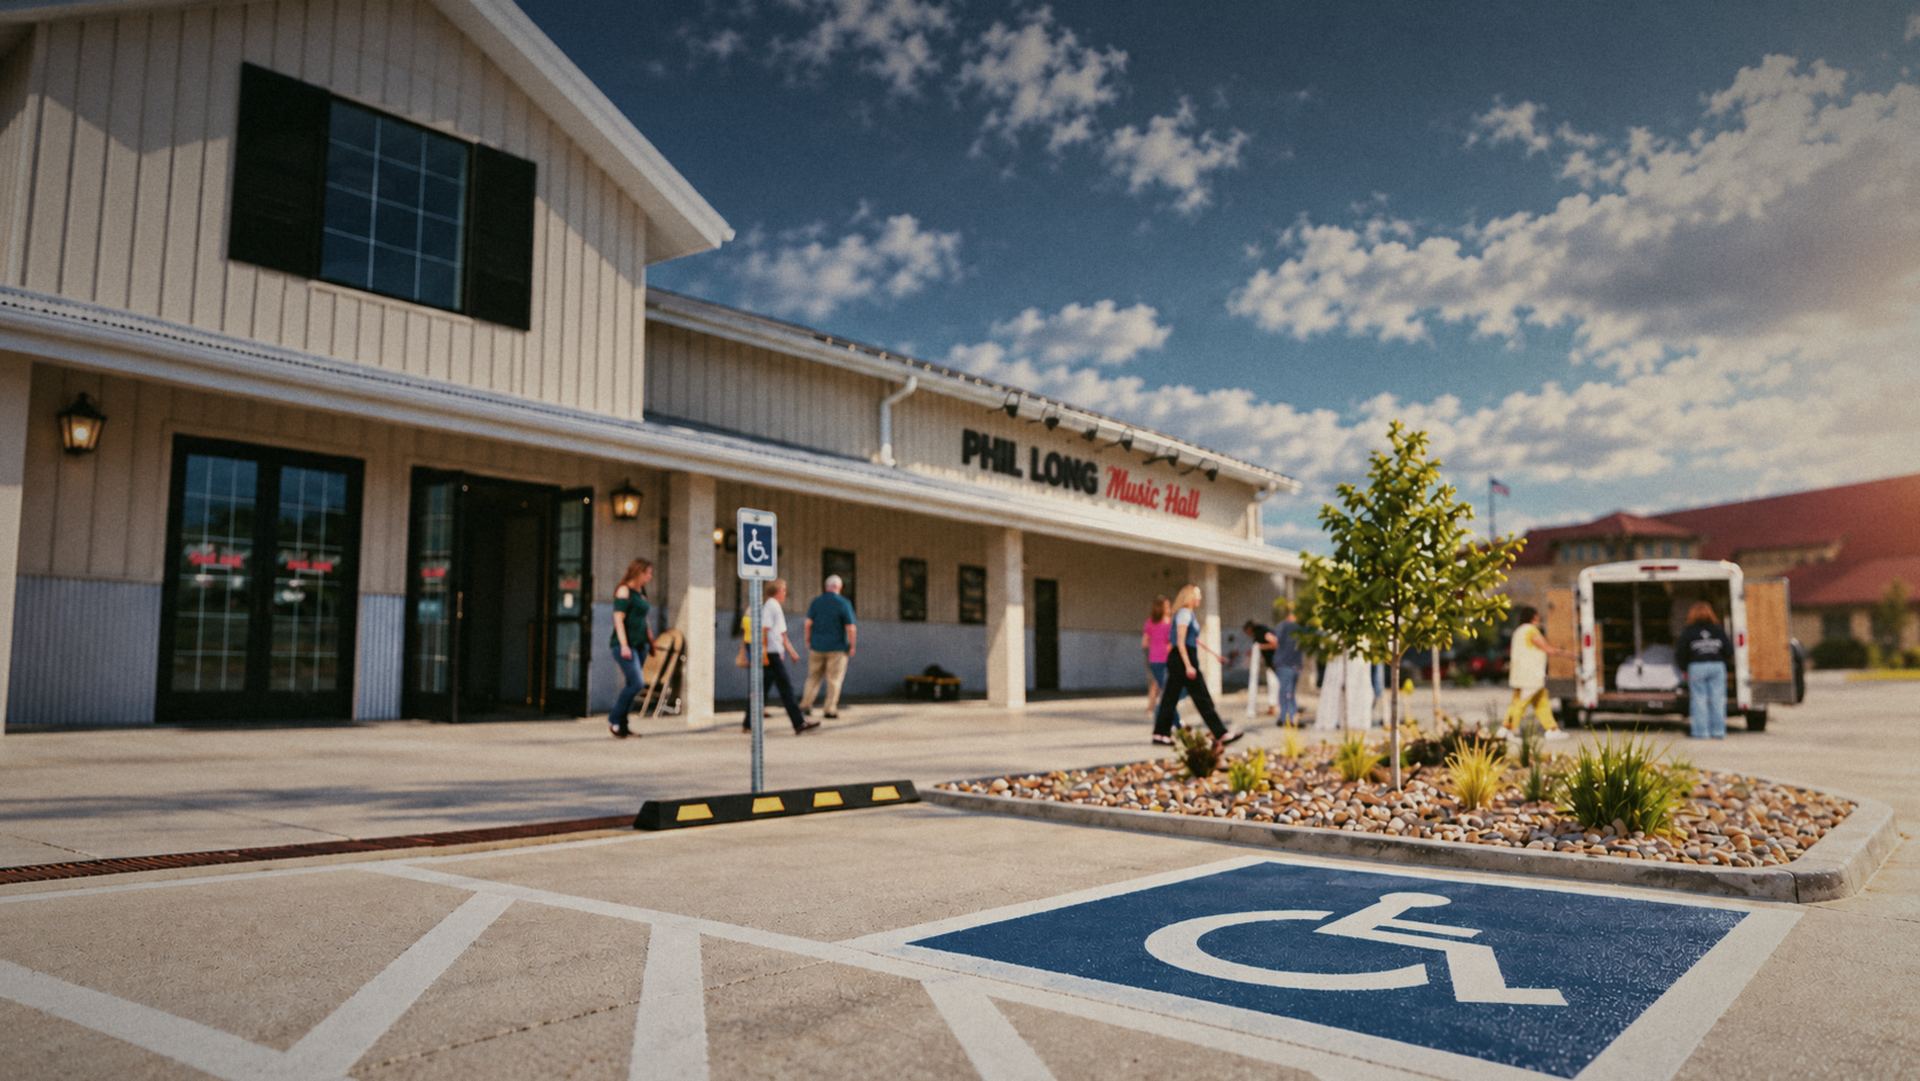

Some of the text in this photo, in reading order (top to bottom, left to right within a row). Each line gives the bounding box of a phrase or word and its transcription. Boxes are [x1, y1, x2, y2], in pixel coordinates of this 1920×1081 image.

[961, 428, 1200, 519] PHIL LONG Music Hall
